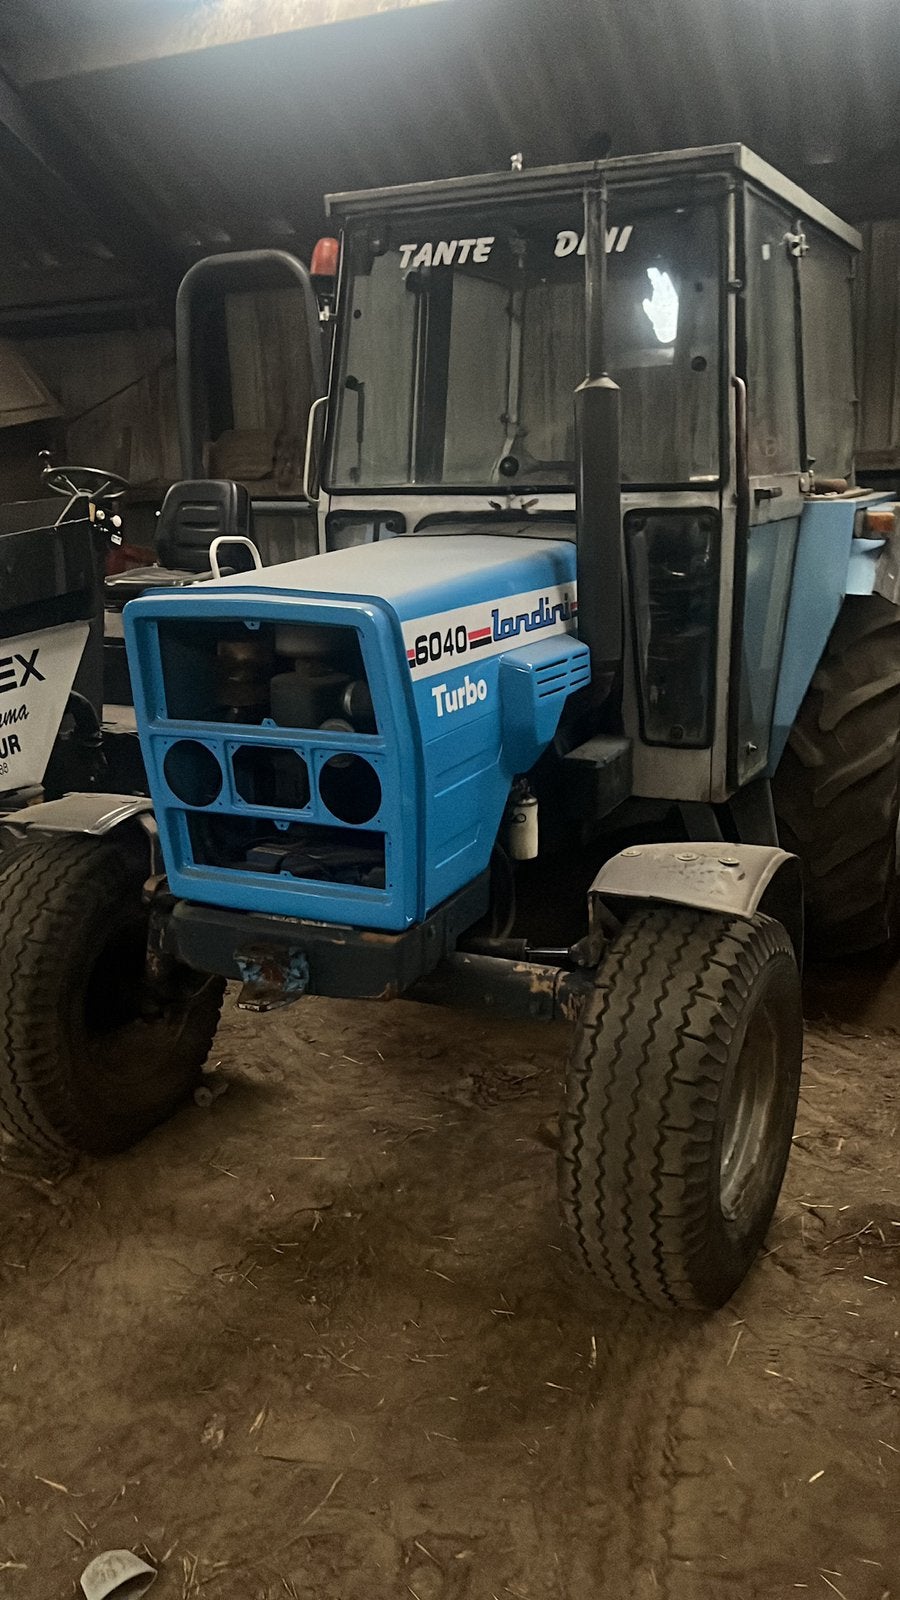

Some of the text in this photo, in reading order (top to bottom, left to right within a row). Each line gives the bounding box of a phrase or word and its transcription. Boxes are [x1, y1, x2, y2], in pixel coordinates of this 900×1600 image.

[399, 236, 495, 269] TANTE
[415, 625, 467, 666] 6040
[431, 675, 488, 718] Turbo
